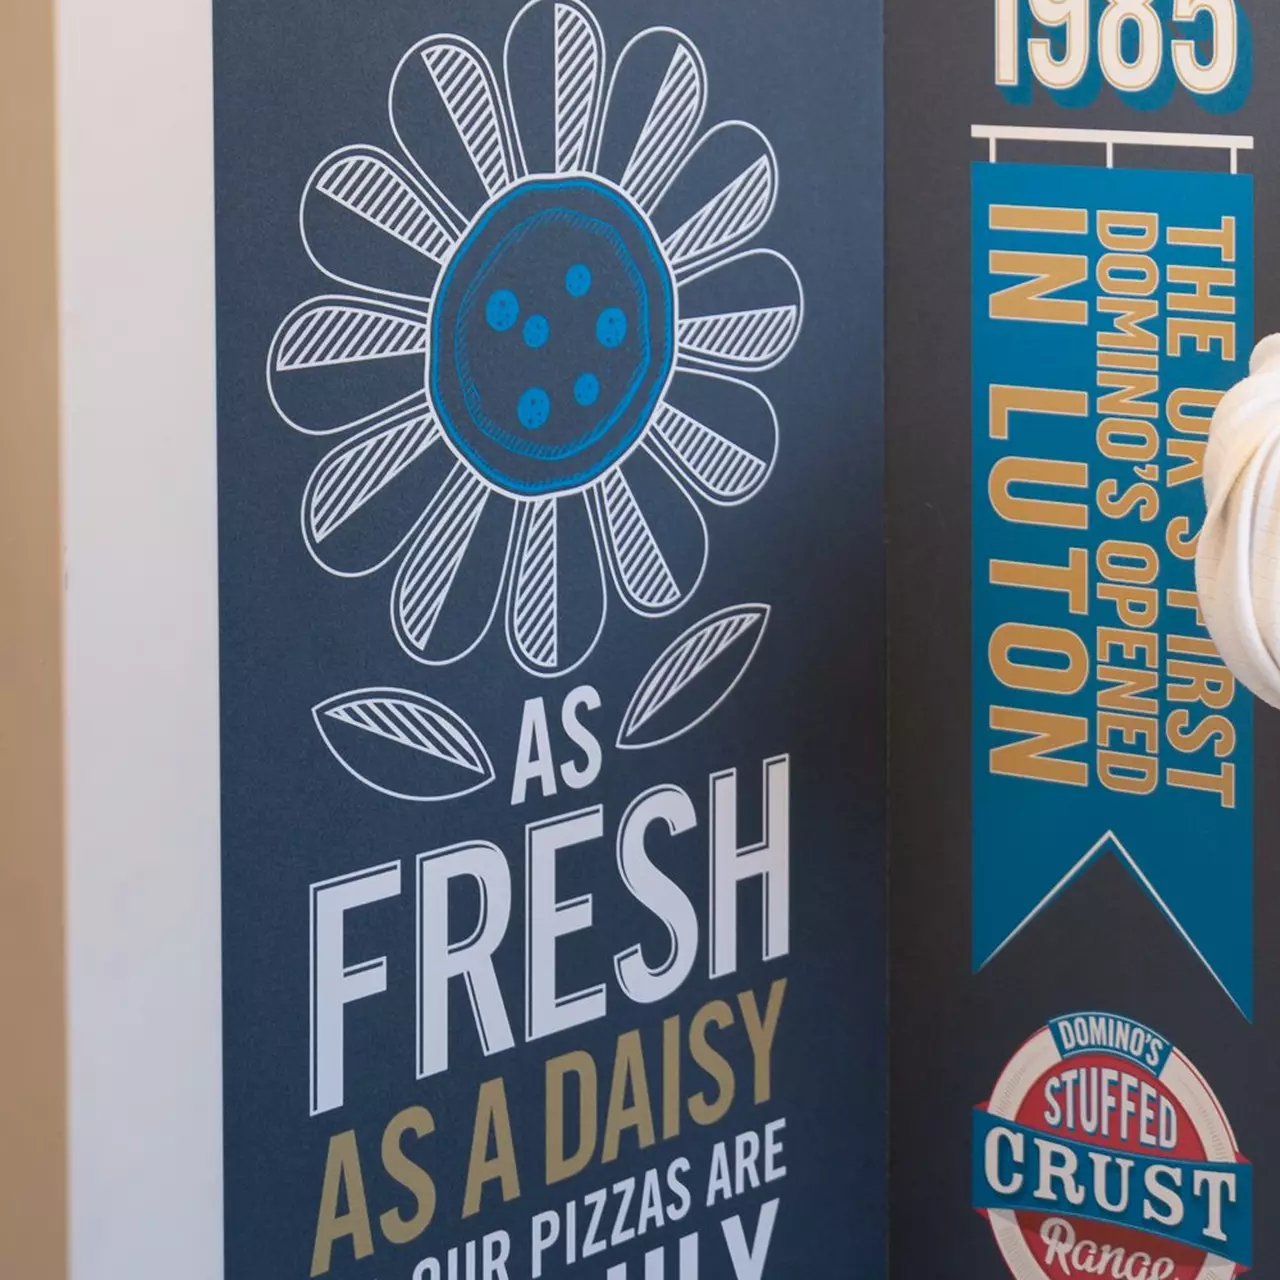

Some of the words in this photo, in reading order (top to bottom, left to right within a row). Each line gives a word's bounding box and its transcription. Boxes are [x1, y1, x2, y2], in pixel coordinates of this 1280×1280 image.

[988, 204, 1090, 326] IN
[1166, 215, 1236, 362] THE
[1096, 210, 1159, 523] DOMINO'S
[988, 383, 1090, 788] LUTON
[510, 684, 603, 805] AS
[1096, 539, 1159, 796] OPENED
[308, 752, 790, 1117] FRESH
[1043, 1066, 1178, 1151] STUFFED
[1057, 1015, 1165, 1067] DOMINO'S
[310, 1104, 437, 1278] AS
[461, 1076, 521, 1219] A
[544, 978, 788, 1187] DAISY
[532, 1156, 691, 1280] PIZZAS
[706, 1117, 787, 1208] ARE
[984, 1126, 1237, 1242] CRUST
